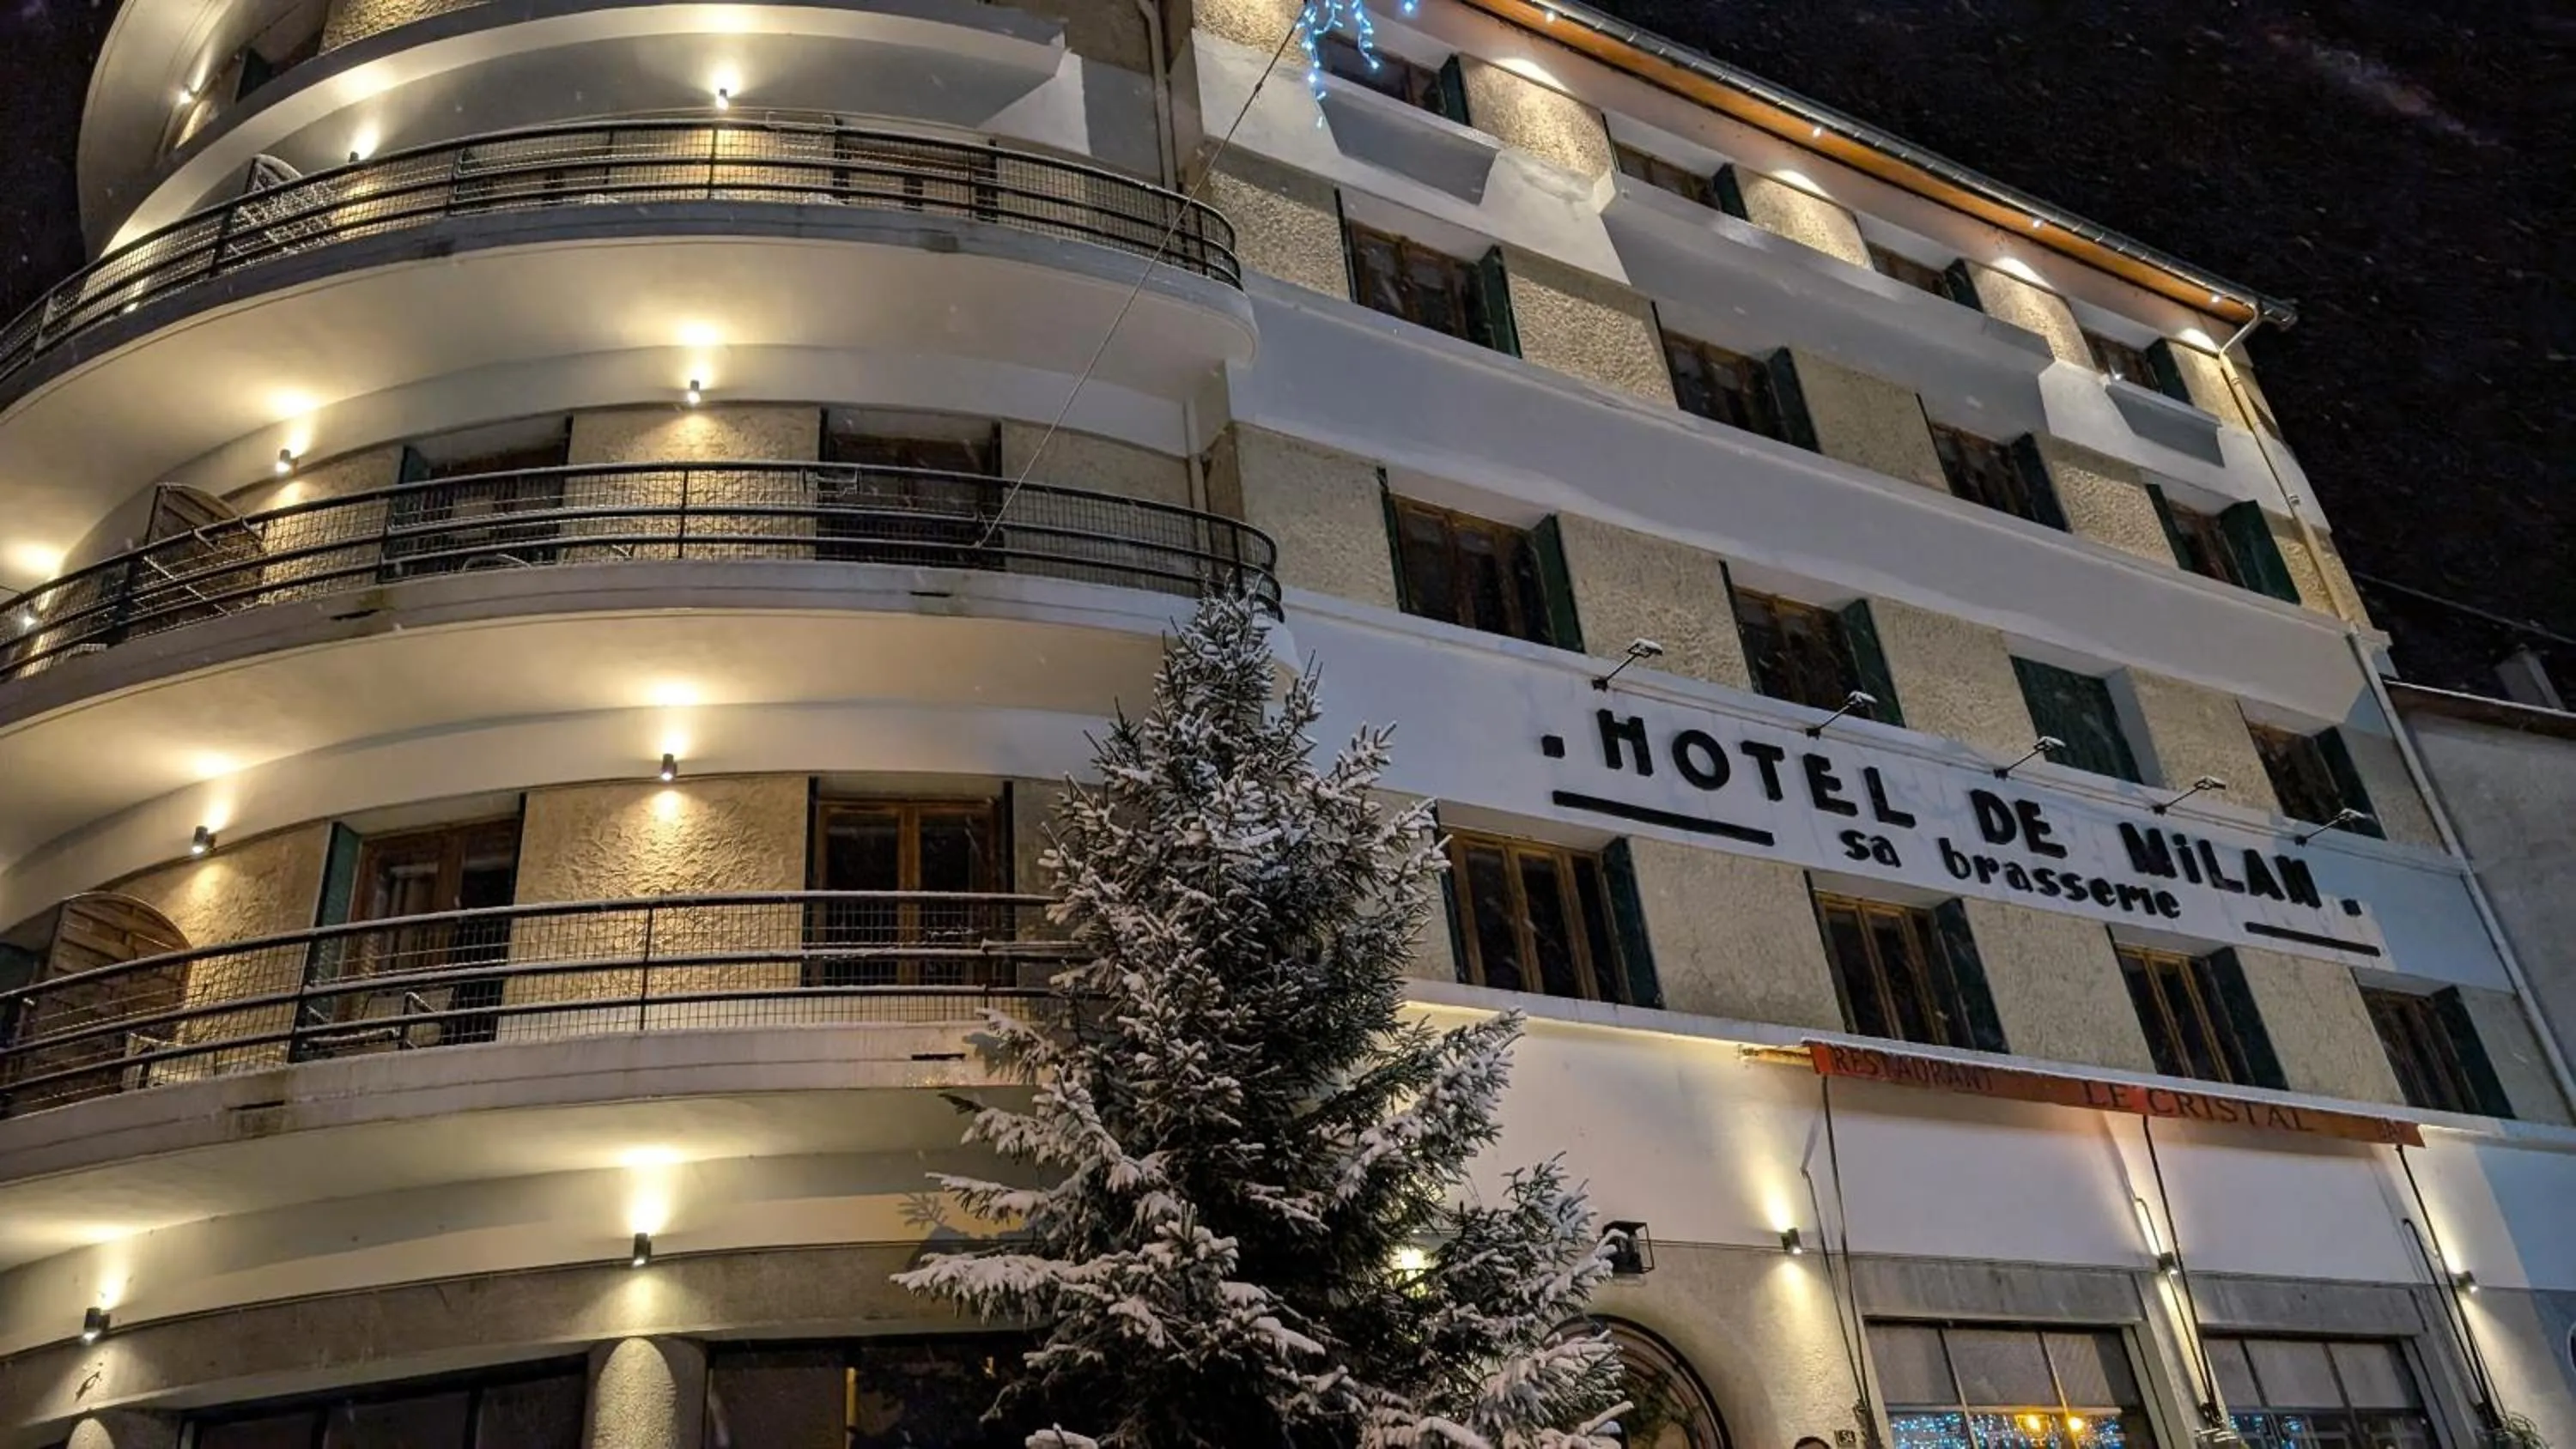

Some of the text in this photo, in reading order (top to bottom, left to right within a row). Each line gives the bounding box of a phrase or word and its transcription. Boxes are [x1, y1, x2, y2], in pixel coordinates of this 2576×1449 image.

[1595, 708, 1915, 828] HOTEL
[1970, 789, 2068, 858] DE
[1839, 829, 2181, 919] sa brasserie
[2081, 1080, 2133, 1108] LE
[2147, 1087, 2316, 1131] CRISTAL
